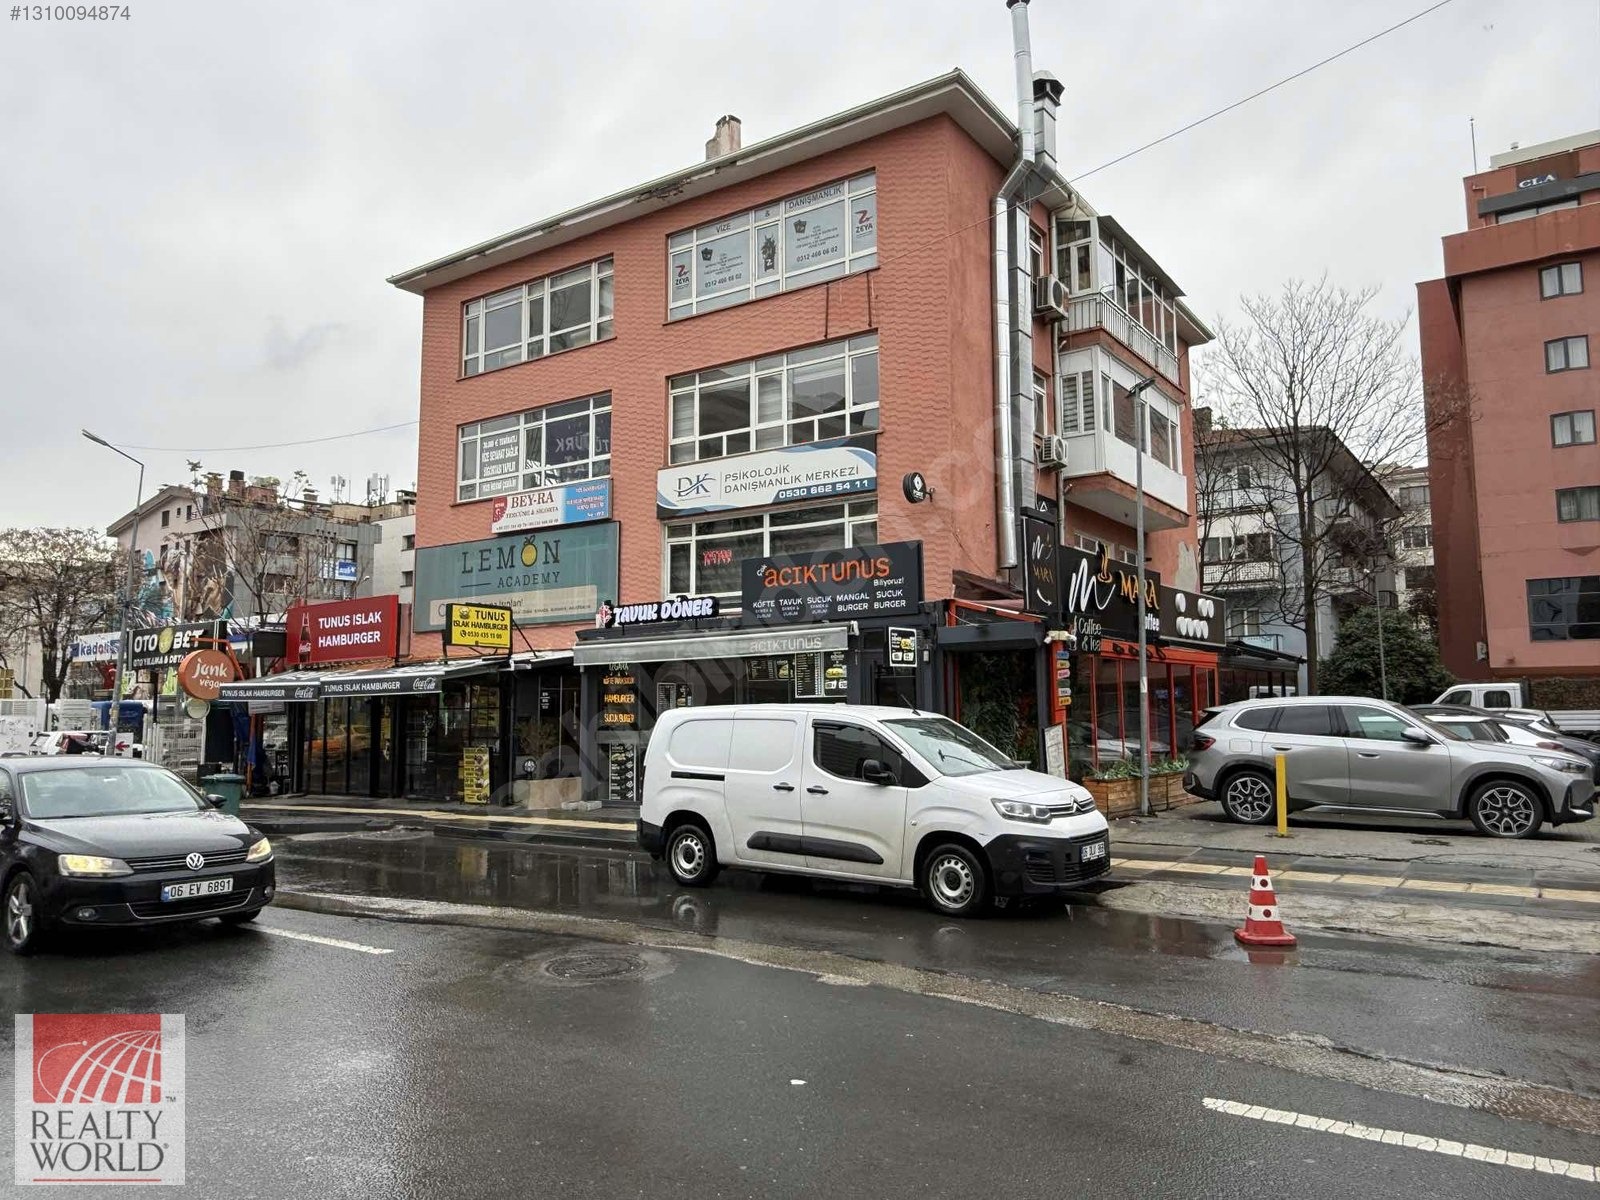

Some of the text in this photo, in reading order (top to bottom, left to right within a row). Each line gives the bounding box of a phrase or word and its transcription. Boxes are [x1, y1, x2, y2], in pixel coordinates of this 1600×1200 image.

[856, 223, 873, 233] ZEYA
[725, 464, 790, 482] PSİKOLOJİK
[725, 464, 859, 494] DANIŞMANLIK MERKEZİ
[779, 480, 868, 499] 0530 662 54 11
[511, 491, 554, 509] BEY-RA
[462, 538, 561, 574] LEMON
[498, 571, 560, 589] ACADEMY
[753, 595, 832, 609] KÖFTE TAVUK SUCUK
[837, 591, 870, 602] MANGAL
[876, 589, 903, 599] SUCUK
[613, 604, 658, 623] TAVUK
[661, 597, 713, 619] DÖNER
[837, 603, 869, 612] BURGER
[874, 600, 906, 609] BURGER
[318, 611, 382, 630] TUNUS ISLAK
[475, 610, 505, 621] TUNUS
[471, 622, 508, 631] HAMBURGER
[1079, 617, 1101, 636] Coffee
[134, 633, 157, 653] OTO
[318, 630, 381, 648] HAMBURGER
[192, 658, 227, 679] junk
[253, 689, 285, 697] HAMBURGER
[324, 684, 342, 693] TUNUS
[343, 683, 360, 692] ISLAK
[361, 681, 400, 691] HAMBURGER
[604, 694, 636, 703] HAMBURGER
[170, 879, 231, 897] 06 EV 6891
